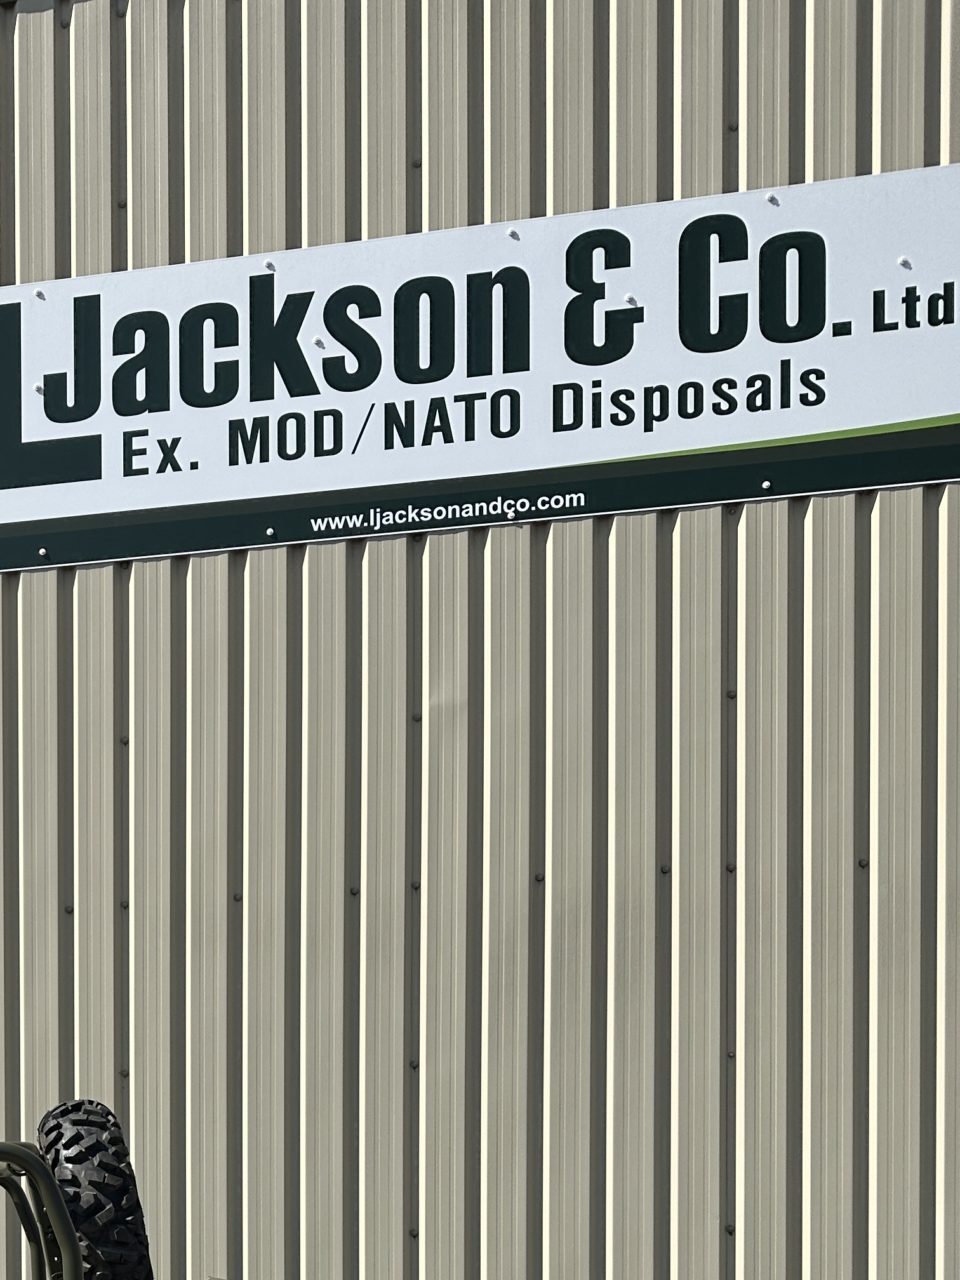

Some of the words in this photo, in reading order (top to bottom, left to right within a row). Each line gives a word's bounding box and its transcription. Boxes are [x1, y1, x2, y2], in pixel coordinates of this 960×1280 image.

[563, 228, 645, 366] &
[678, 213, 852, 354] Co.
[872, 281, 955, 333] Ltd
[122, 429, 199, 477] Ex.
[228, 388, 521, 467] MOD/NATO
[552, 358, 826, 433] Disposals
[310, 492, 585, 532] www.ljacksonandco.com
